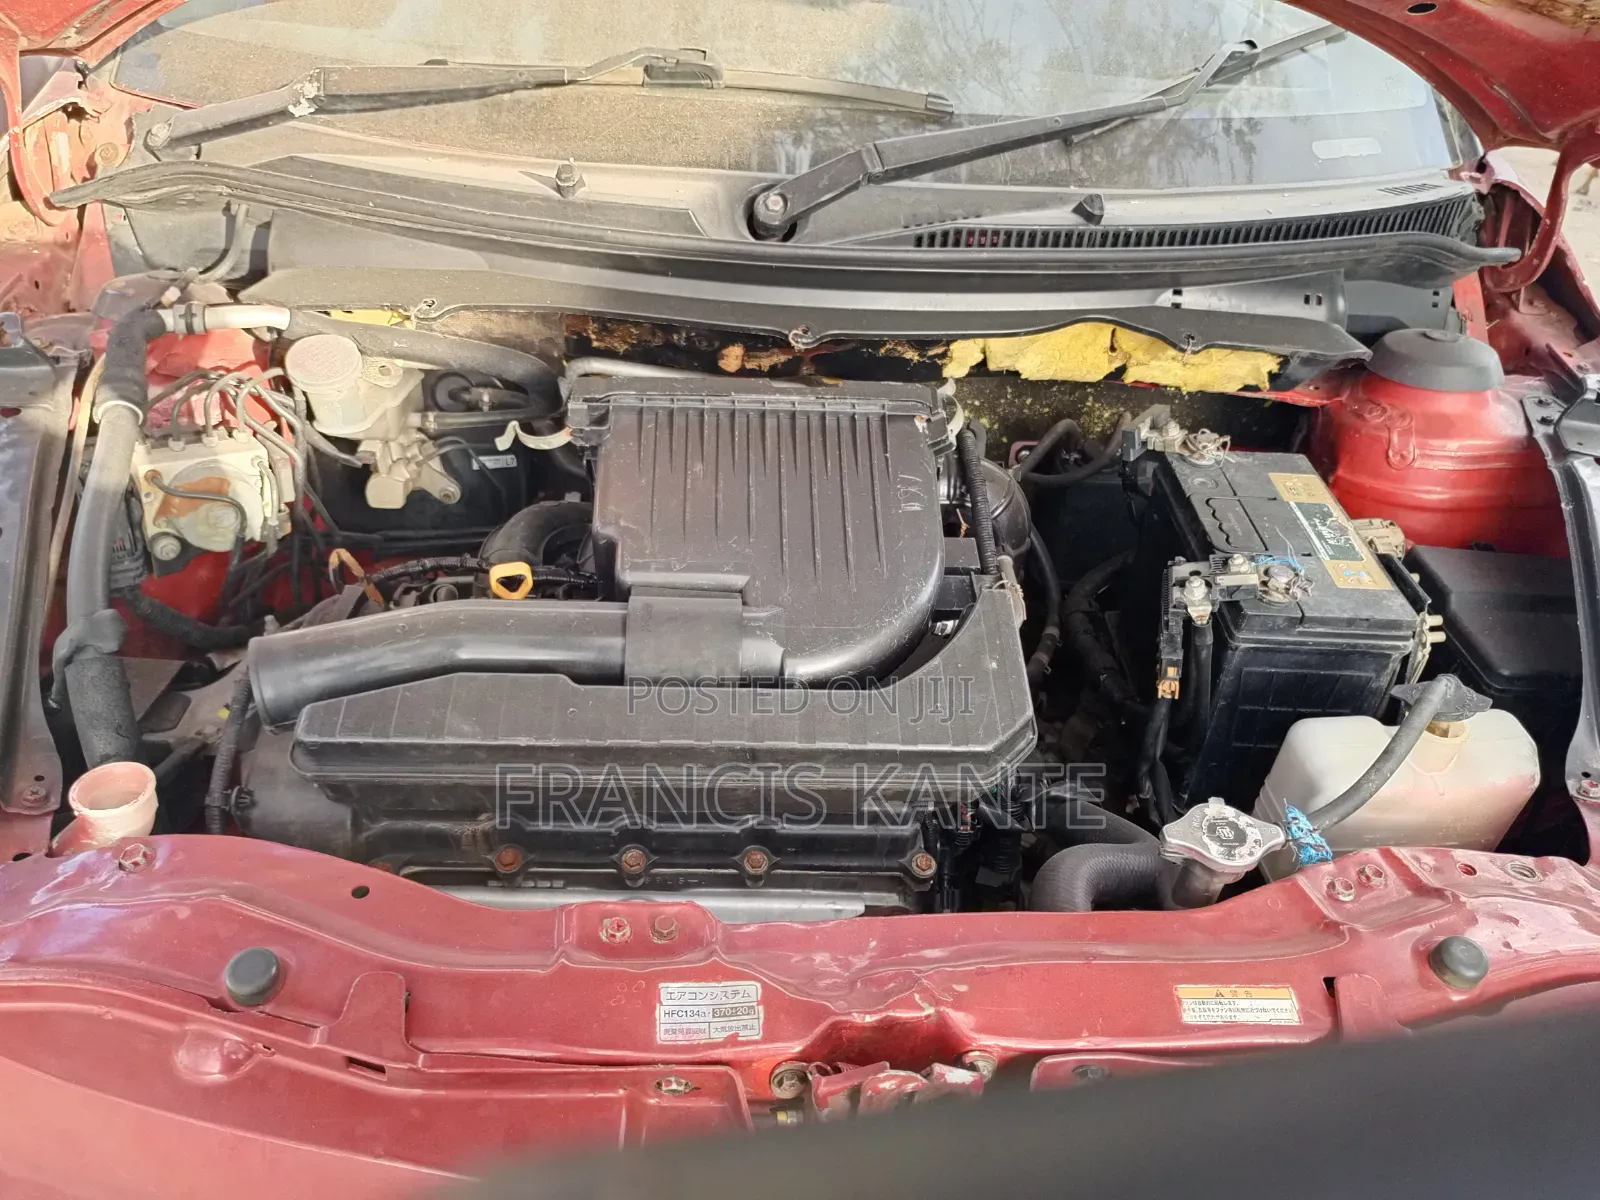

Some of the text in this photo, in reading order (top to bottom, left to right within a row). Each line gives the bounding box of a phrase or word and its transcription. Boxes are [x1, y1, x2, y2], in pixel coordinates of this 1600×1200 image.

[666, 989, 752, 1001] エアコンシステム
